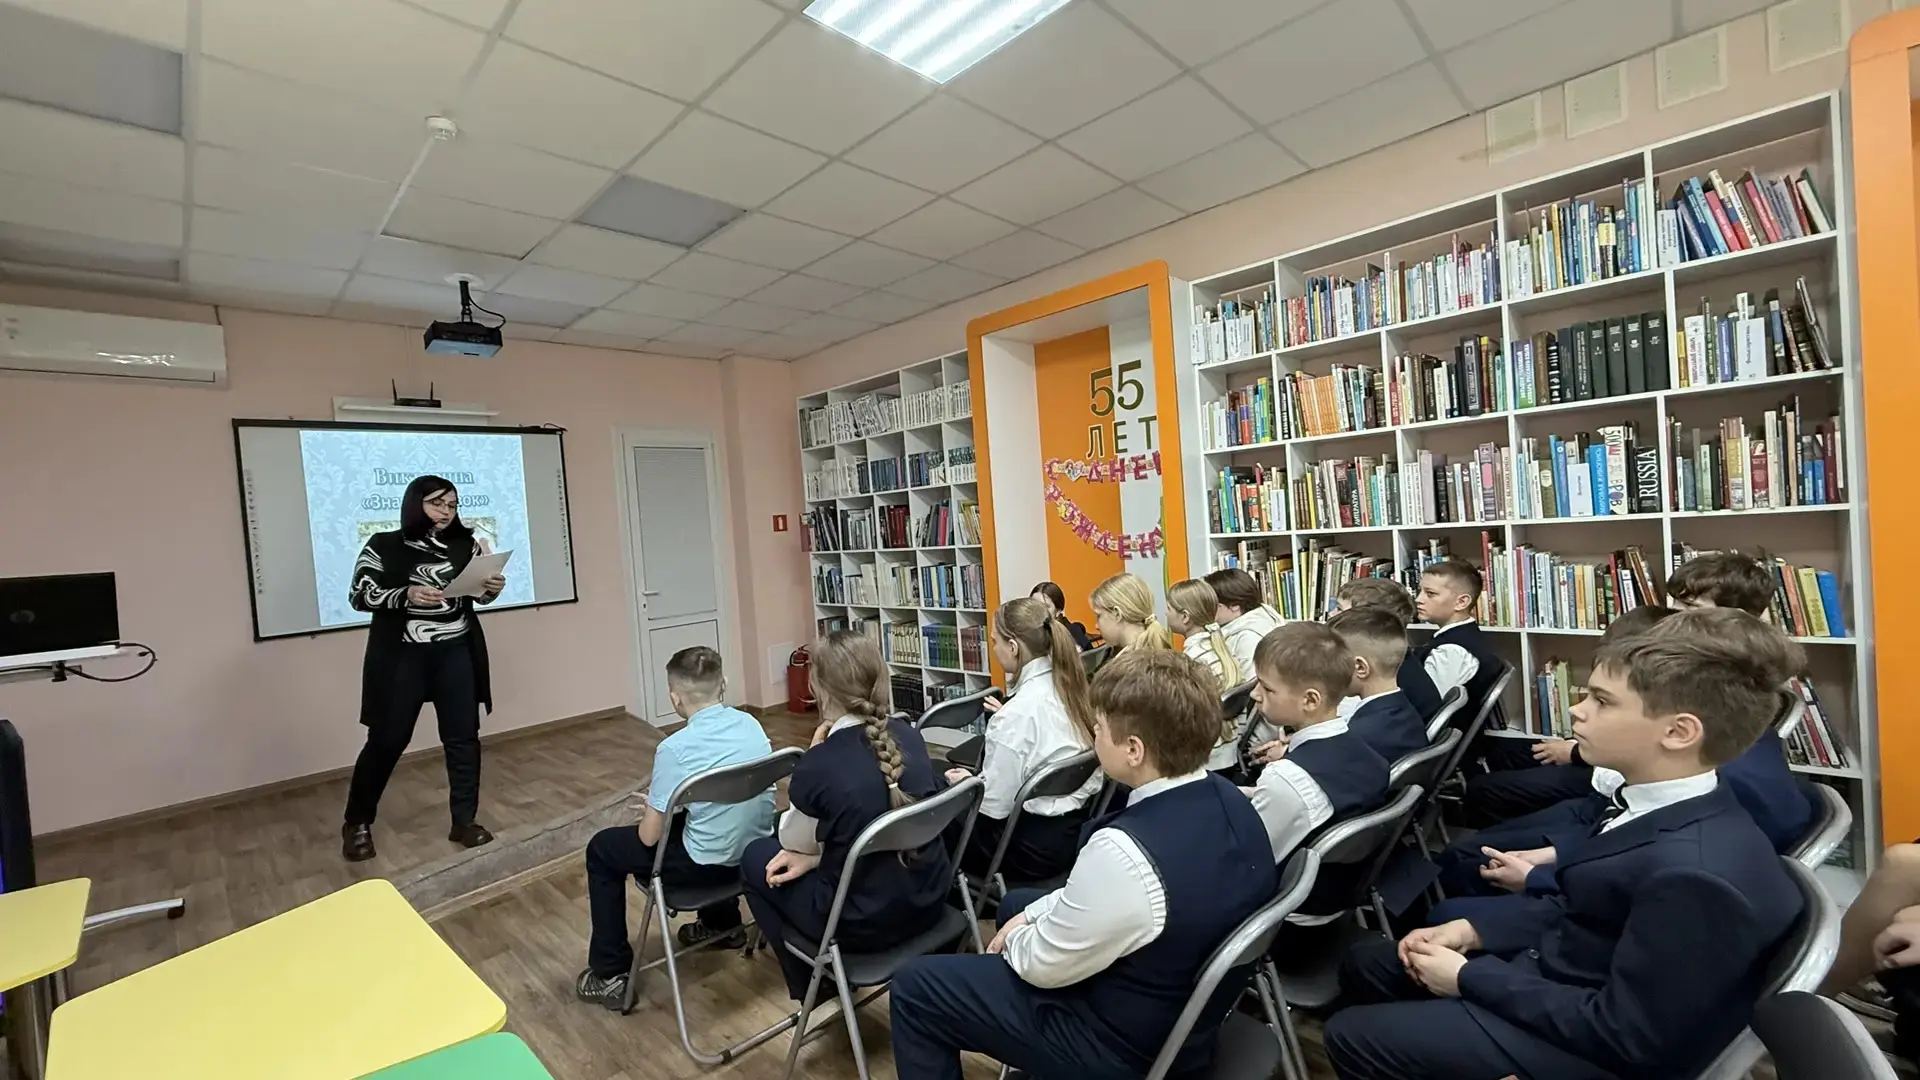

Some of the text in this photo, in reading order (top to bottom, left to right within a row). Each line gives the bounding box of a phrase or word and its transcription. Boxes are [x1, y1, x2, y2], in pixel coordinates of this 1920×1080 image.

[1090, 360, 1145, 417] 55
[1087, 415, 1157, 458] ЛЕТ
[1043, 458, 1060, 481] С
[1637, 448, 1659, 498] RUSSIA
[1351, 488, 1361, 526] ЛИТЕРАТУРА
